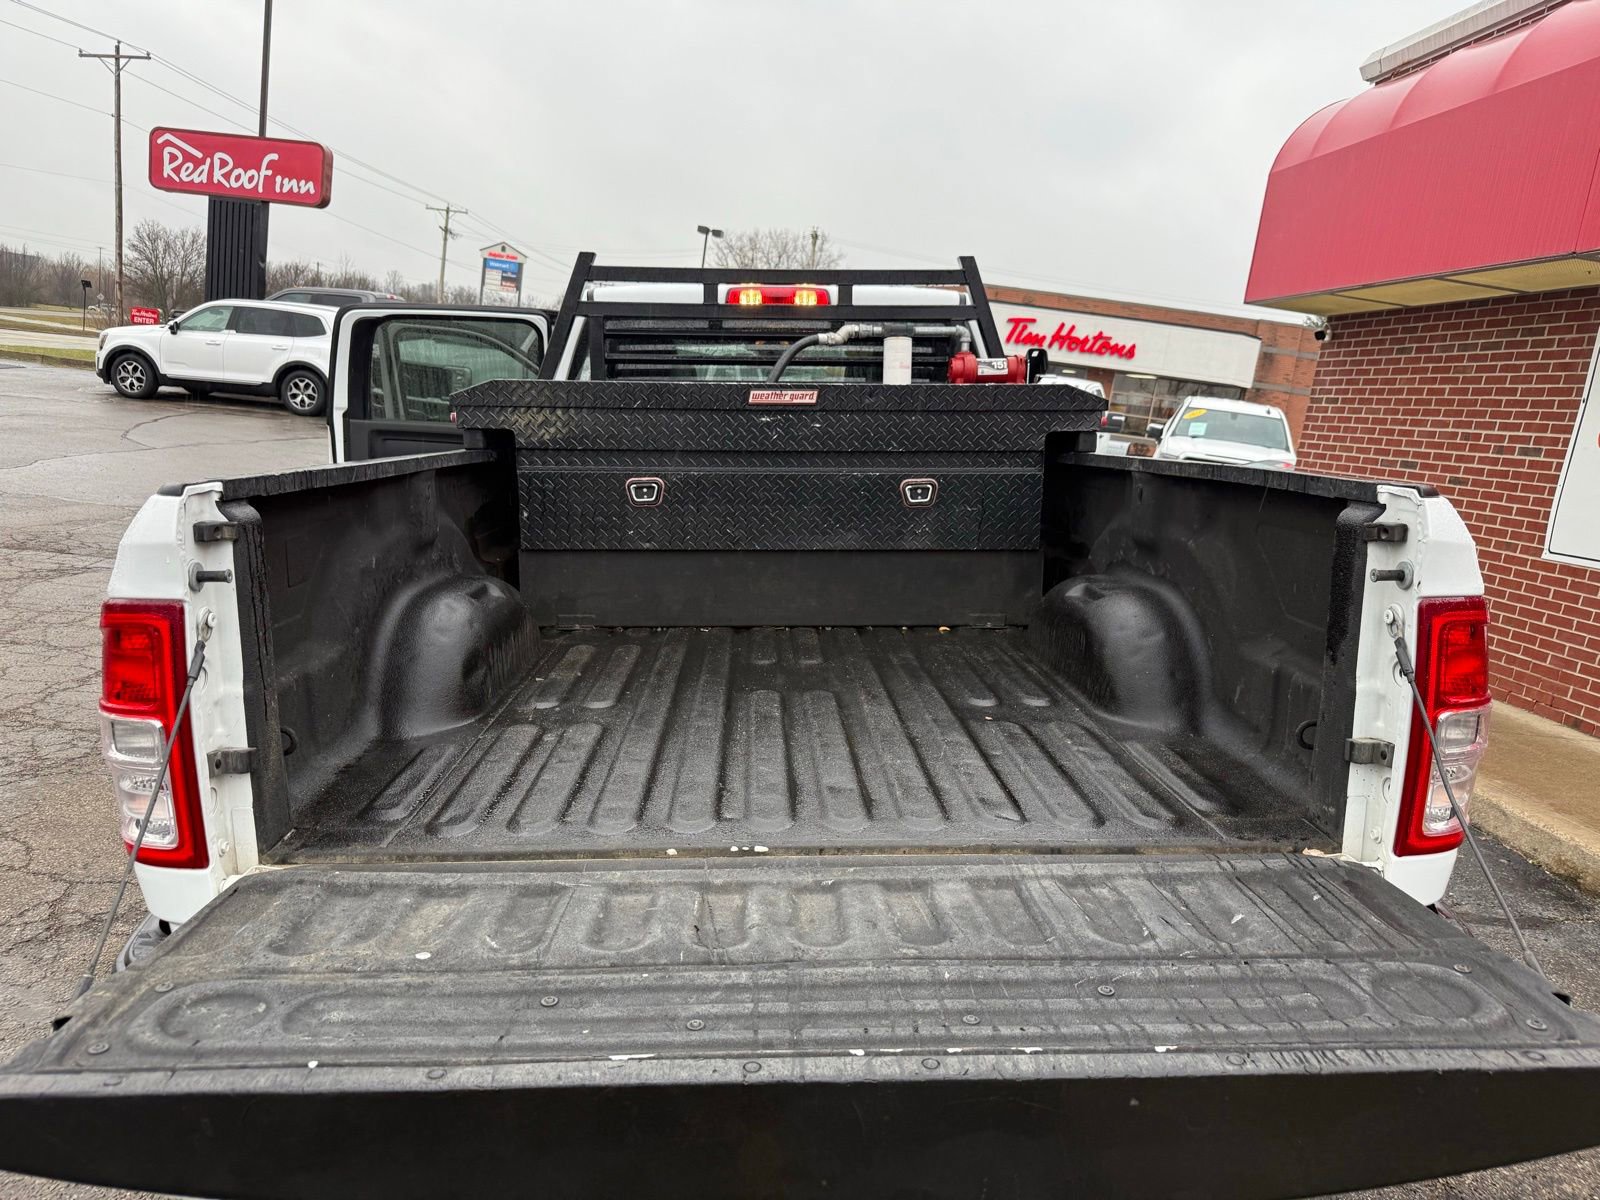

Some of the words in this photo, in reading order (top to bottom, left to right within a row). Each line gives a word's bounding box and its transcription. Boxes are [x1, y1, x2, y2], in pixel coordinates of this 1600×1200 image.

[163, 146, 211, 183] Red
[213, 152, 279, 193] Roof
[134, 316, 155, 324] ENTER
[1005, 317, 1047, 348] Tim
[1048, 322, 1136, 360] Hortons
[752, 391, 789, 401] weather
[789, 391, 815, 402] guard
